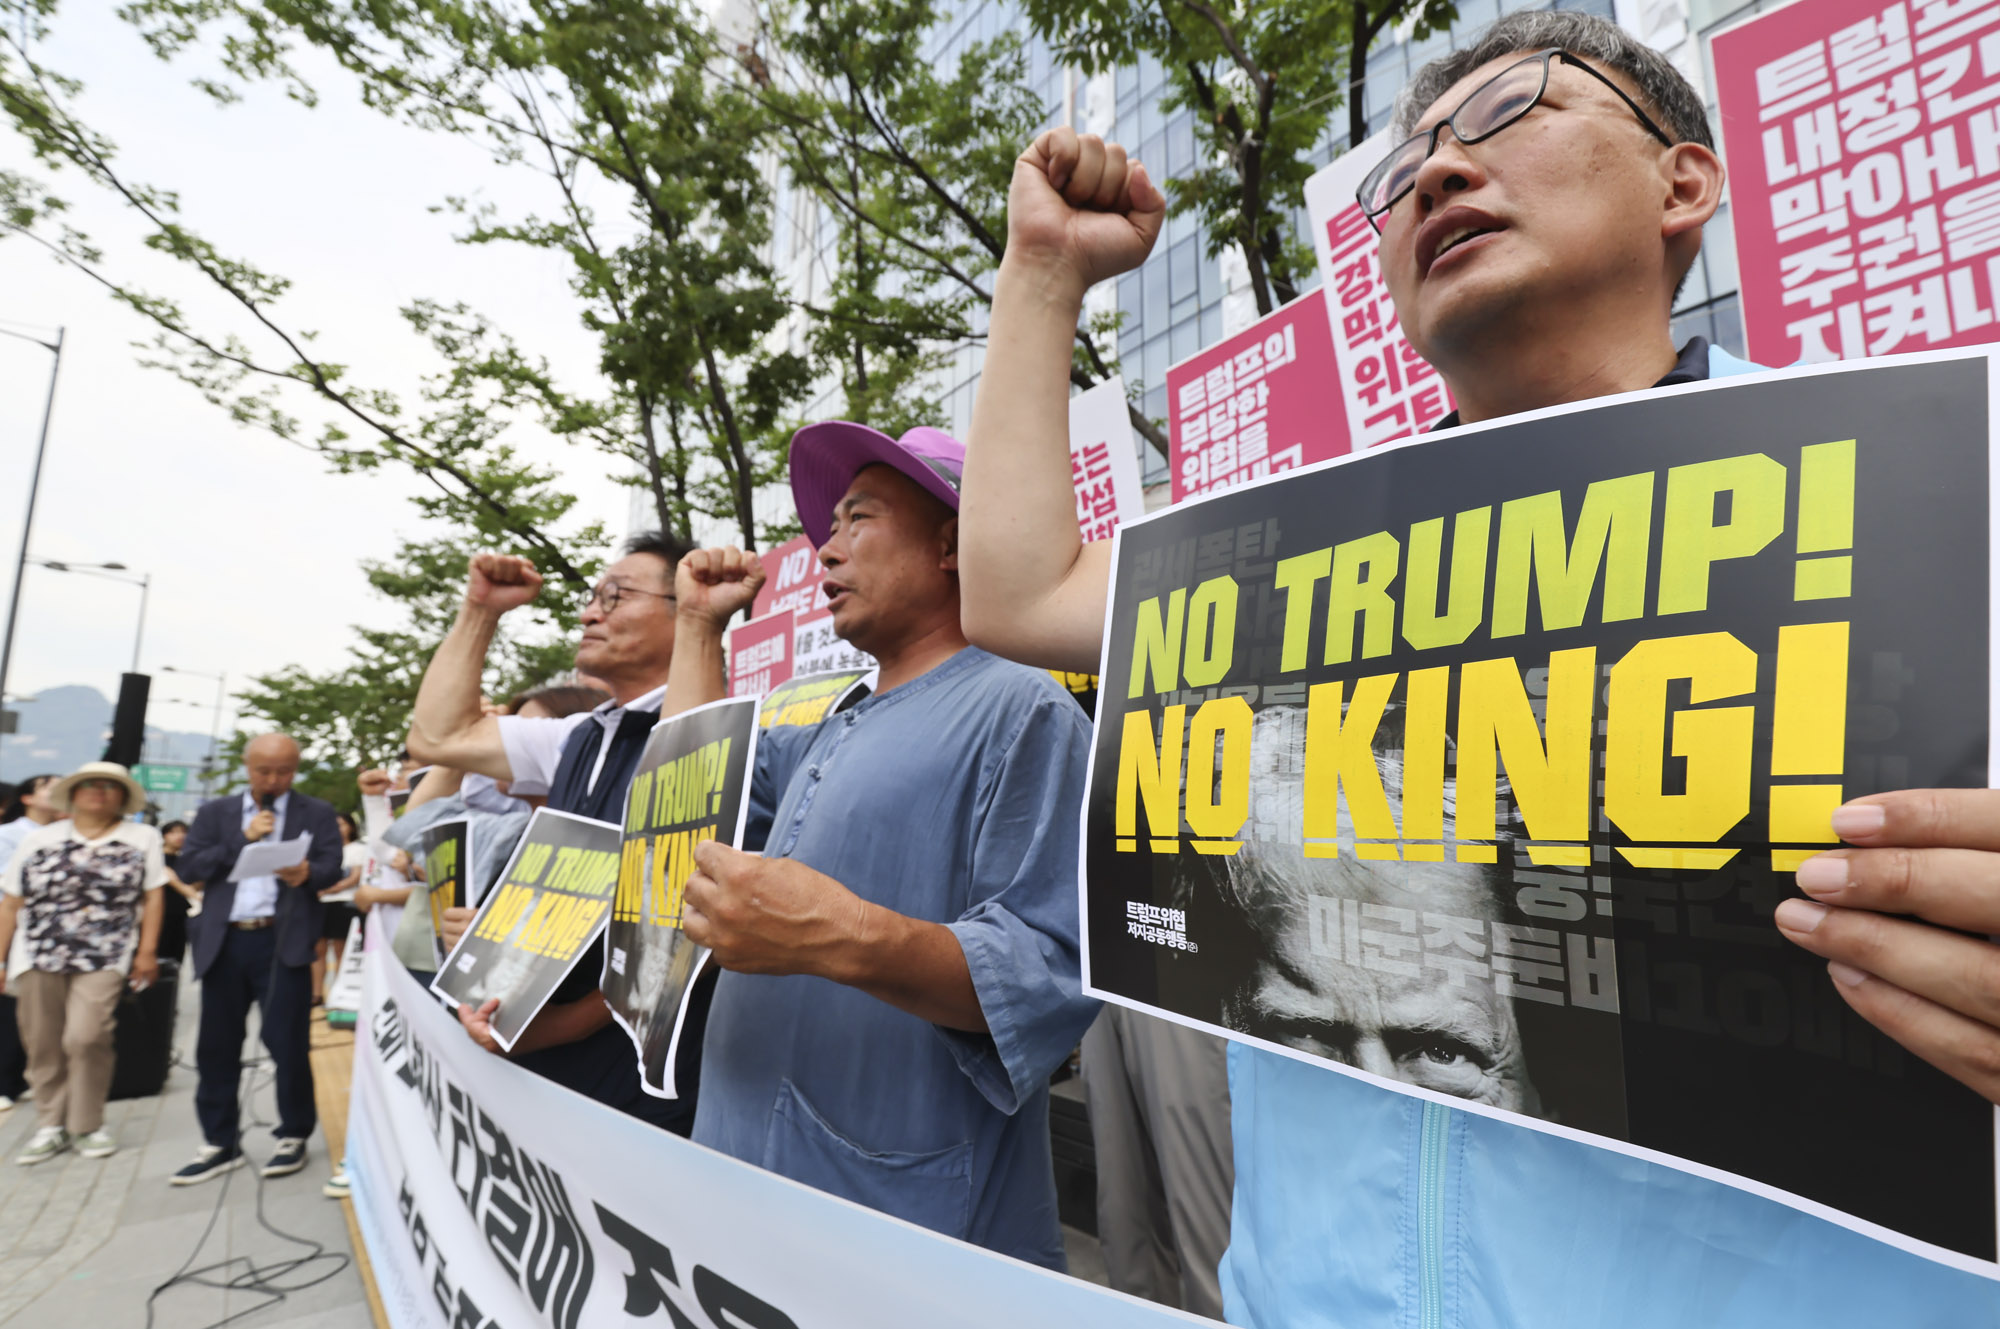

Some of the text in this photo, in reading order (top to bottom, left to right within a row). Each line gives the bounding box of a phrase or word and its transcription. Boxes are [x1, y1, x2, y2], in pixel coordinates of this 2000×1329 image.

[1178, 323, 1297, 420] 트럼프의
[1180, 379, 1270, 453] 부당한
[1182, 420, 1269, 492] 위협을
[775, 547, 811, 592] NO
[1128, 438, 1857, 699] NO TRUMP!
[627, 737, 732, 834] NO TRUMP!
[1115, 694, 1255, 857] NO
[1302, 621, 1851, 873] KING!
[510, 842, 553, 884] NO
[614, 837, 647, 923] NO
[474, 883, 534, 944] NO
[513, 891, 609, 961] KING!
[1126, 900, 1186, 932] 트럼프위협
